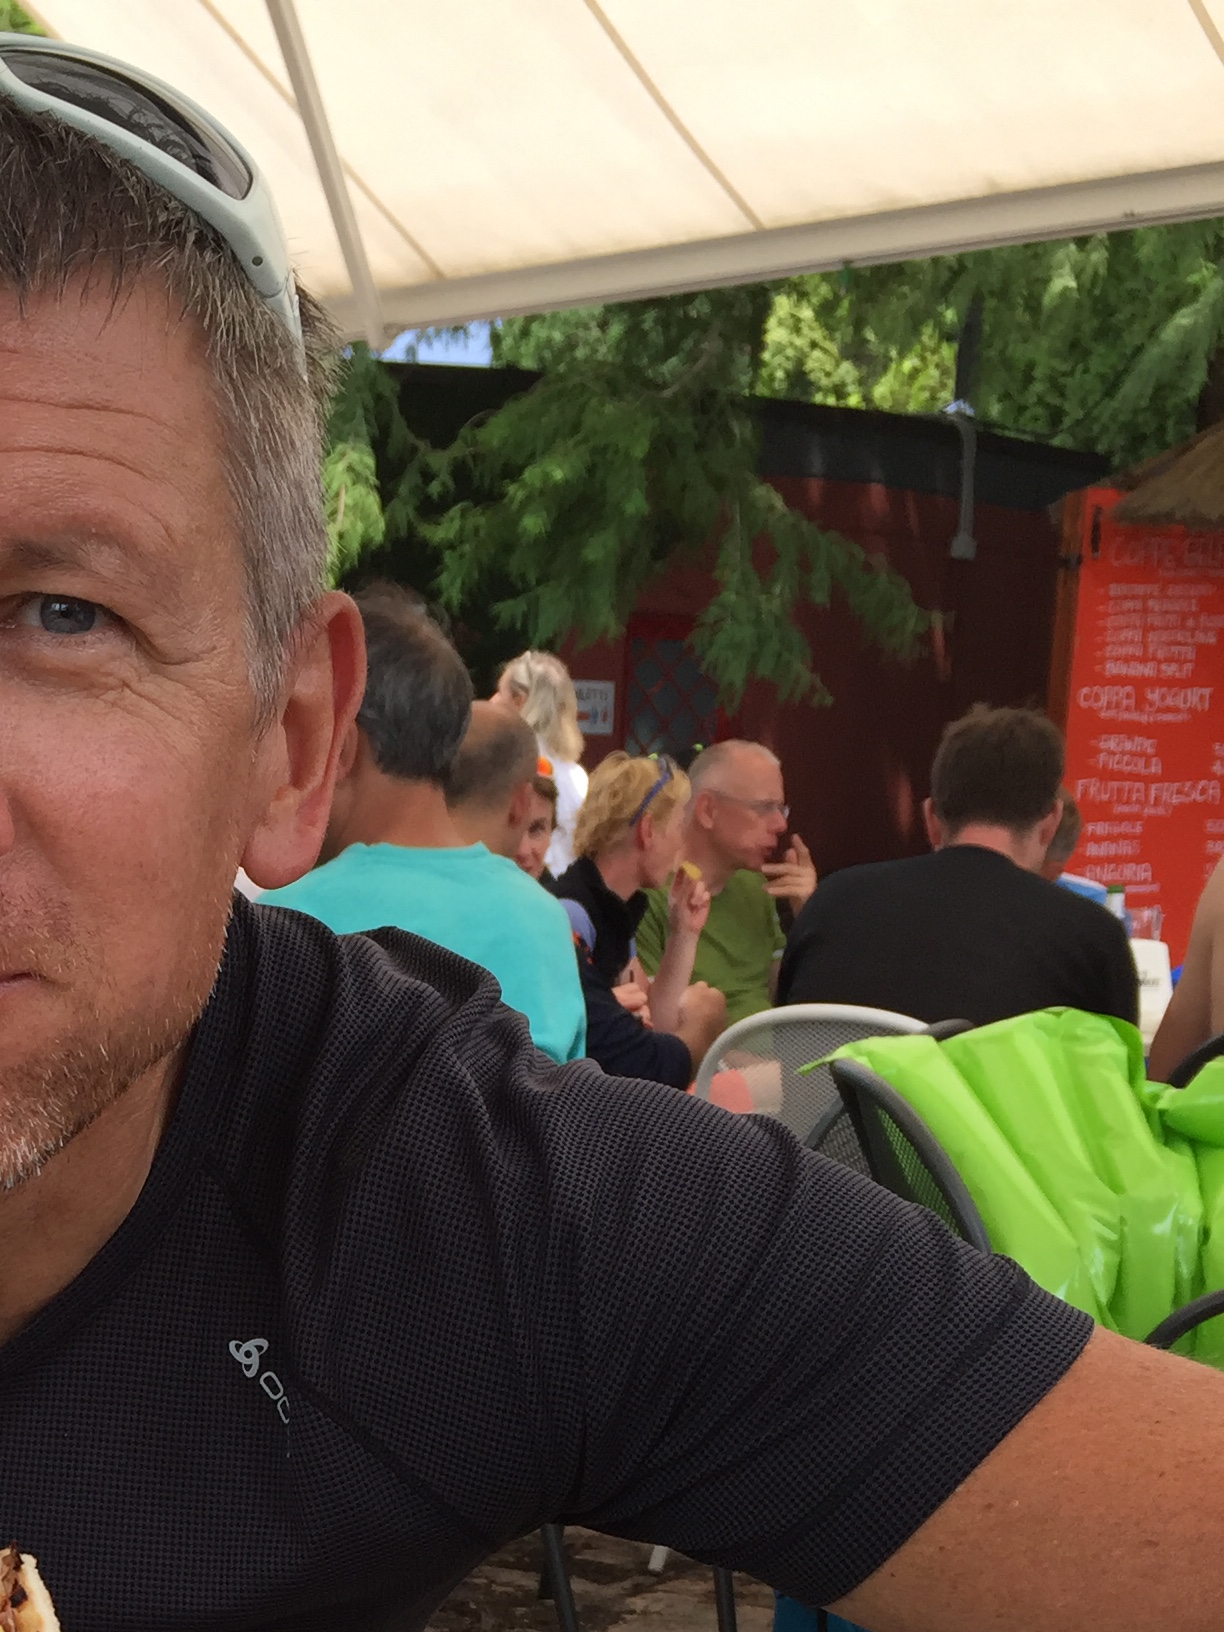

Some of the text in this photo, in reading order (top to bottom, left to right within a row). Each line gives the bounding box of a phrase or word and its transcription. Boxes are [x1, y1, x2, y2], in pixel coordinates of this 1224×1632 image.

[1078, 685, 1214, 712] COPPA YOGURT
[1097, 751, 1162, 775] PICCOLA
[1076, 777, 1221, 805] FRUTTA FRESCA
